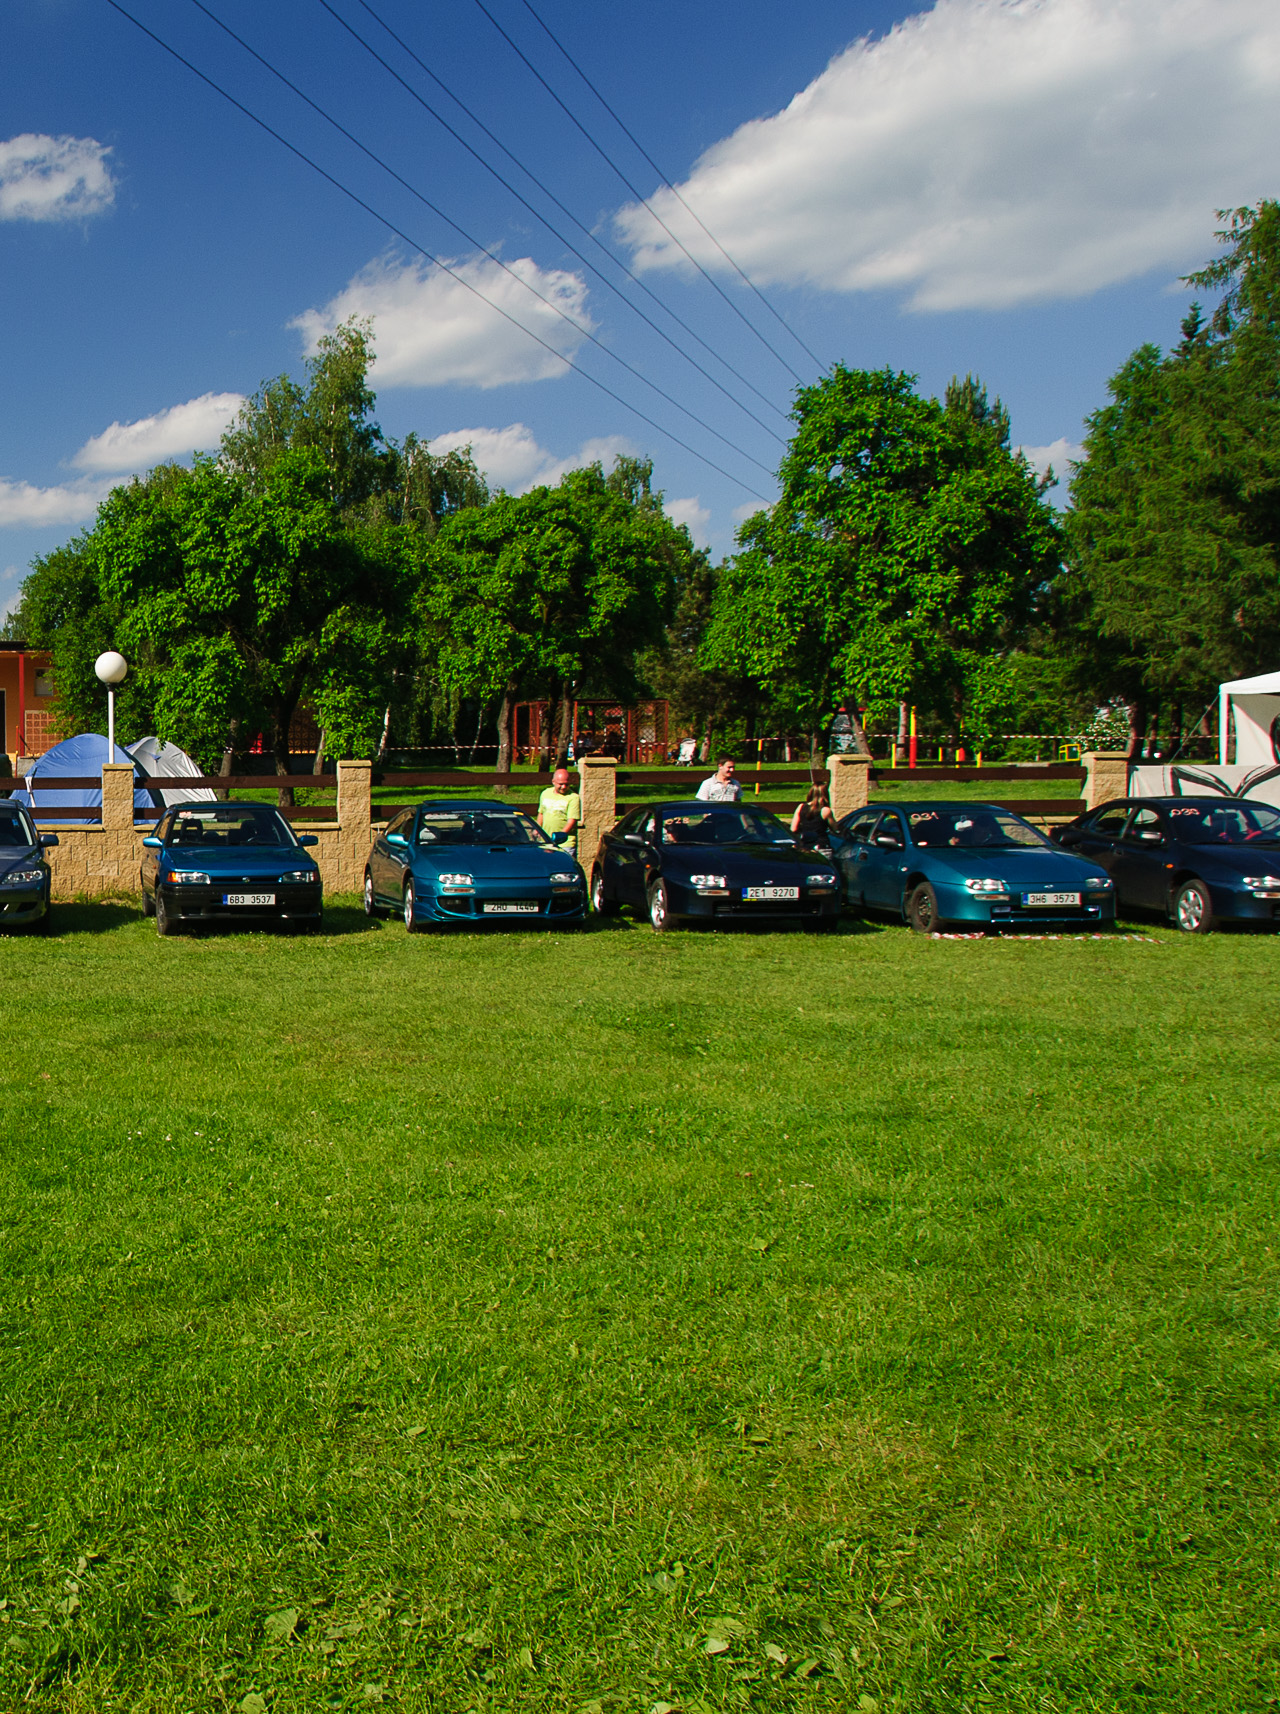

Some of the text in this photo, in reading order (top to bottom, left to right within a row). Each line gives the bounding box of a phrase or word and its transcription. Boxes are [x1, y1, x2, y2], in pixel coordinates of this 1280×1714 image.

[749, 889, 795, 897] 2E1 9270
[230, 896, 271, 904] 6B3 3537
[1030, 894, 1075, 903] 3H6 3573
